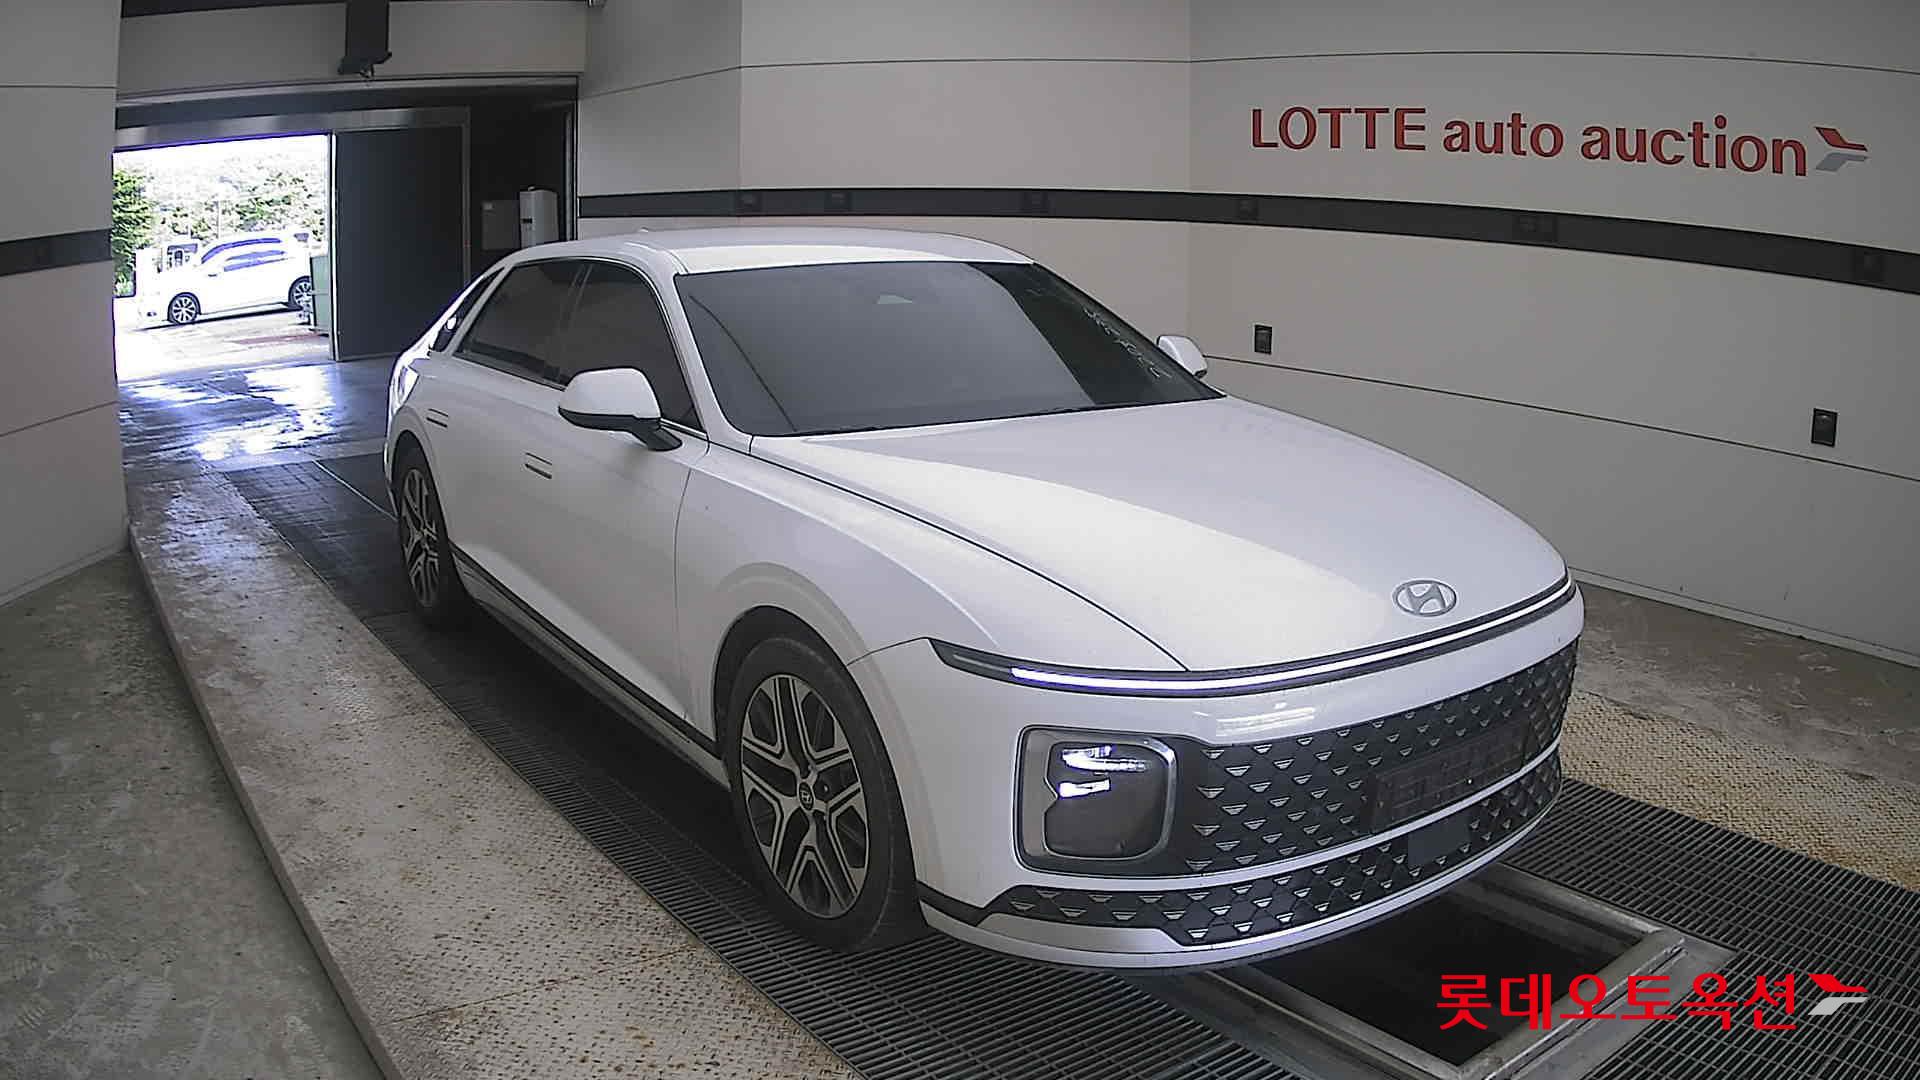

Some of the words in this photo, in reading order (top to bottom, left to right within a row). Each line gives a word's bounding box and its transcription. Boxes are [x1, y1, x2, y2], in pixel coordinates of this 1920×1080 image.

[1251, 106, 1427, 151] LOTTE
[1443, 113, 1564, 158] auto
[1580, 115, 1808, 177] auction
